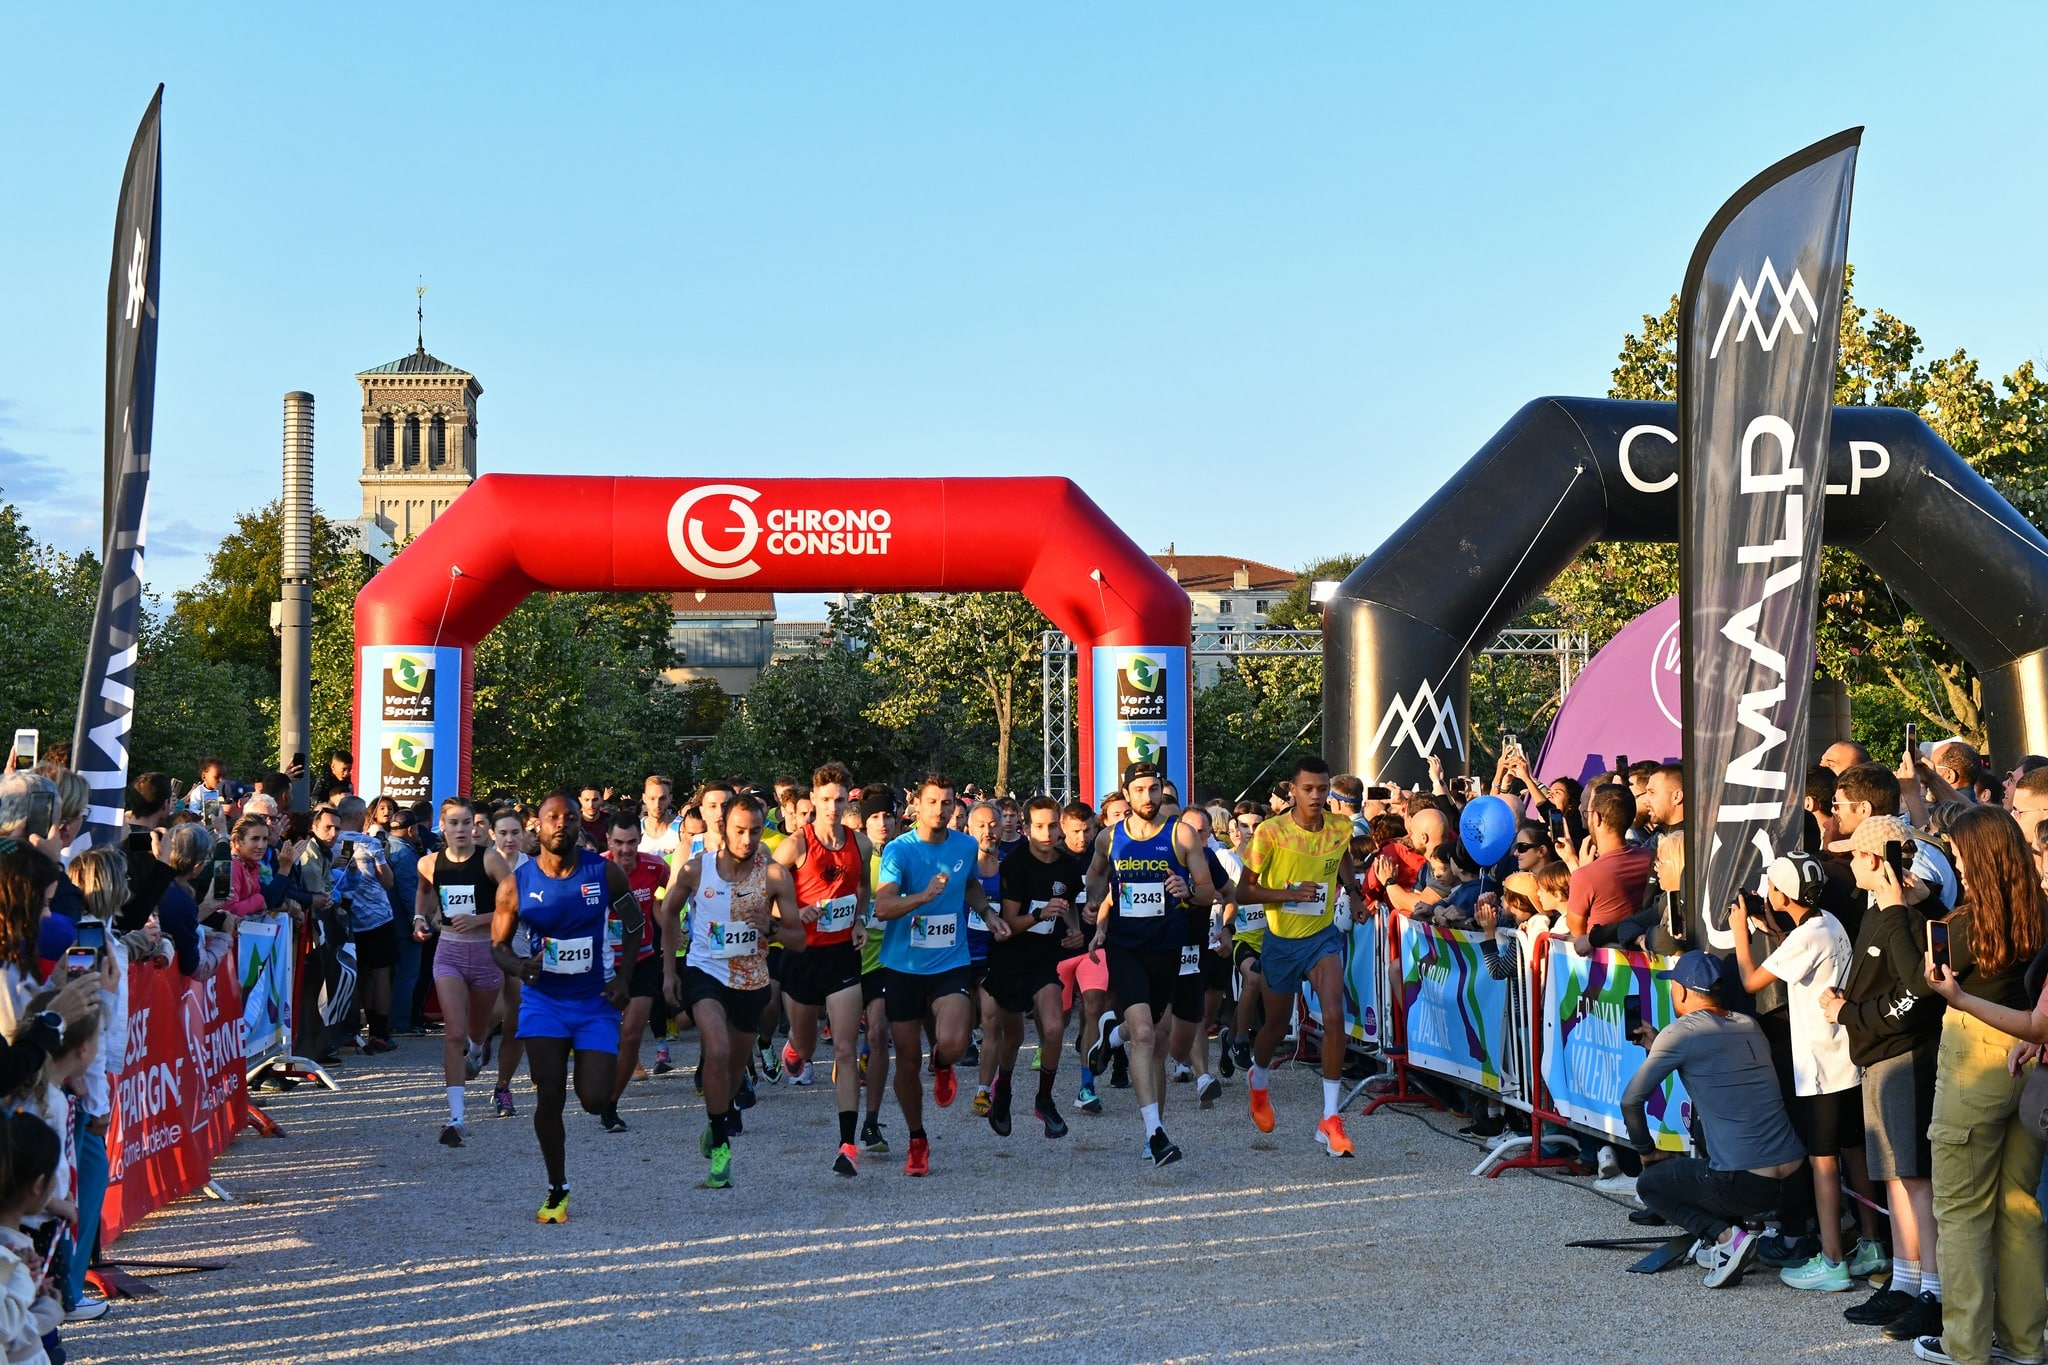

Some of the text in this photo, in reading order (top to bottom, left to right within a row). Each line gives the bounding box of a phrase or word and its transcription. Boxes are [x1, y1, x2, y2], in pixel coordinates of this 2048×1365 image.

[766, 508, 892, 532] CHRONO
[766, 532, 892, 556] CONSULT
[1702, 414, 1804, 950] CIMALP
[385, 695, 432, 705] Vert &
[1120, 695, 1165, 705] Vert &
[384, 706, 428, 718] Sport
[1120, 705, 1161, 717] Sport
[383, 775, 430, 785] Vert &
[382, 786, 427, 798] Sport
[1113, 856, 1169, 872] valence
[449, 894, 474, 905] 2271
[586, 896, 599, 906] CUB
[1133, 892, 1162, 904] 2343
[832, 904, 855, 920] 2231
[1246, 911, 1266, 921] 226
[927, 923, 955, 936] 2186
[725, 930, 757, 944] 2128
[559, 948, 591, 962] 2219
[1181, 954, 1198, 964] 346
[1574, 995, 1583, 1041] 5
[1585, 997, 1593, 1043] &
[1572, 1043, 1623, 1106] VALENCE
